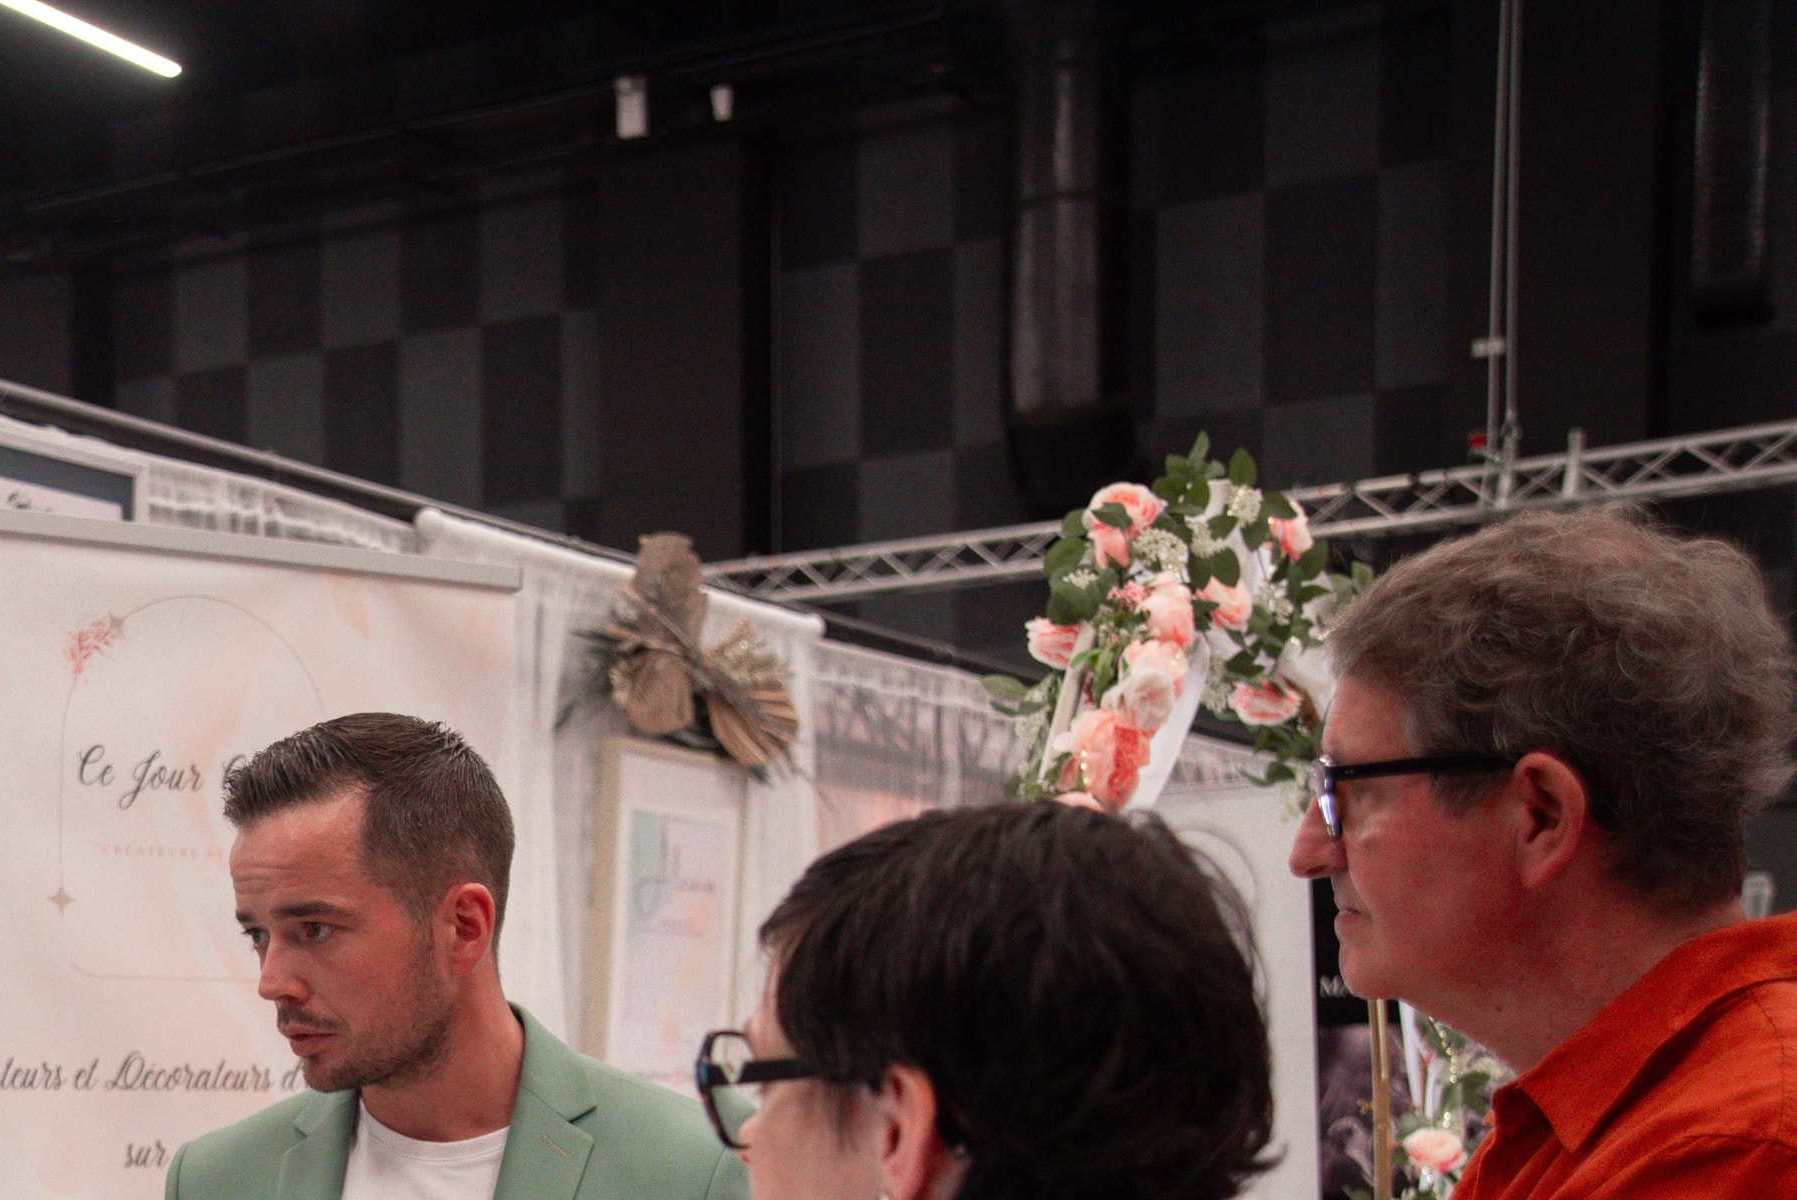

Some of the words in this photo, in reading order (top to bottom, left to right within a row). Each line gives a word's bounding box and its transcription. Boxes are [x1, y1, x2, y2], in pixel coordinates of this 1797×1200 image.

[80, 744, 115, 786] Ce
[119, 750, 205, 811] Jour
[73, 1057, 100, 1092] et
[104, 1050, 273, 1093] Décorateurs
[124, 1139, 170, 1169] sur
